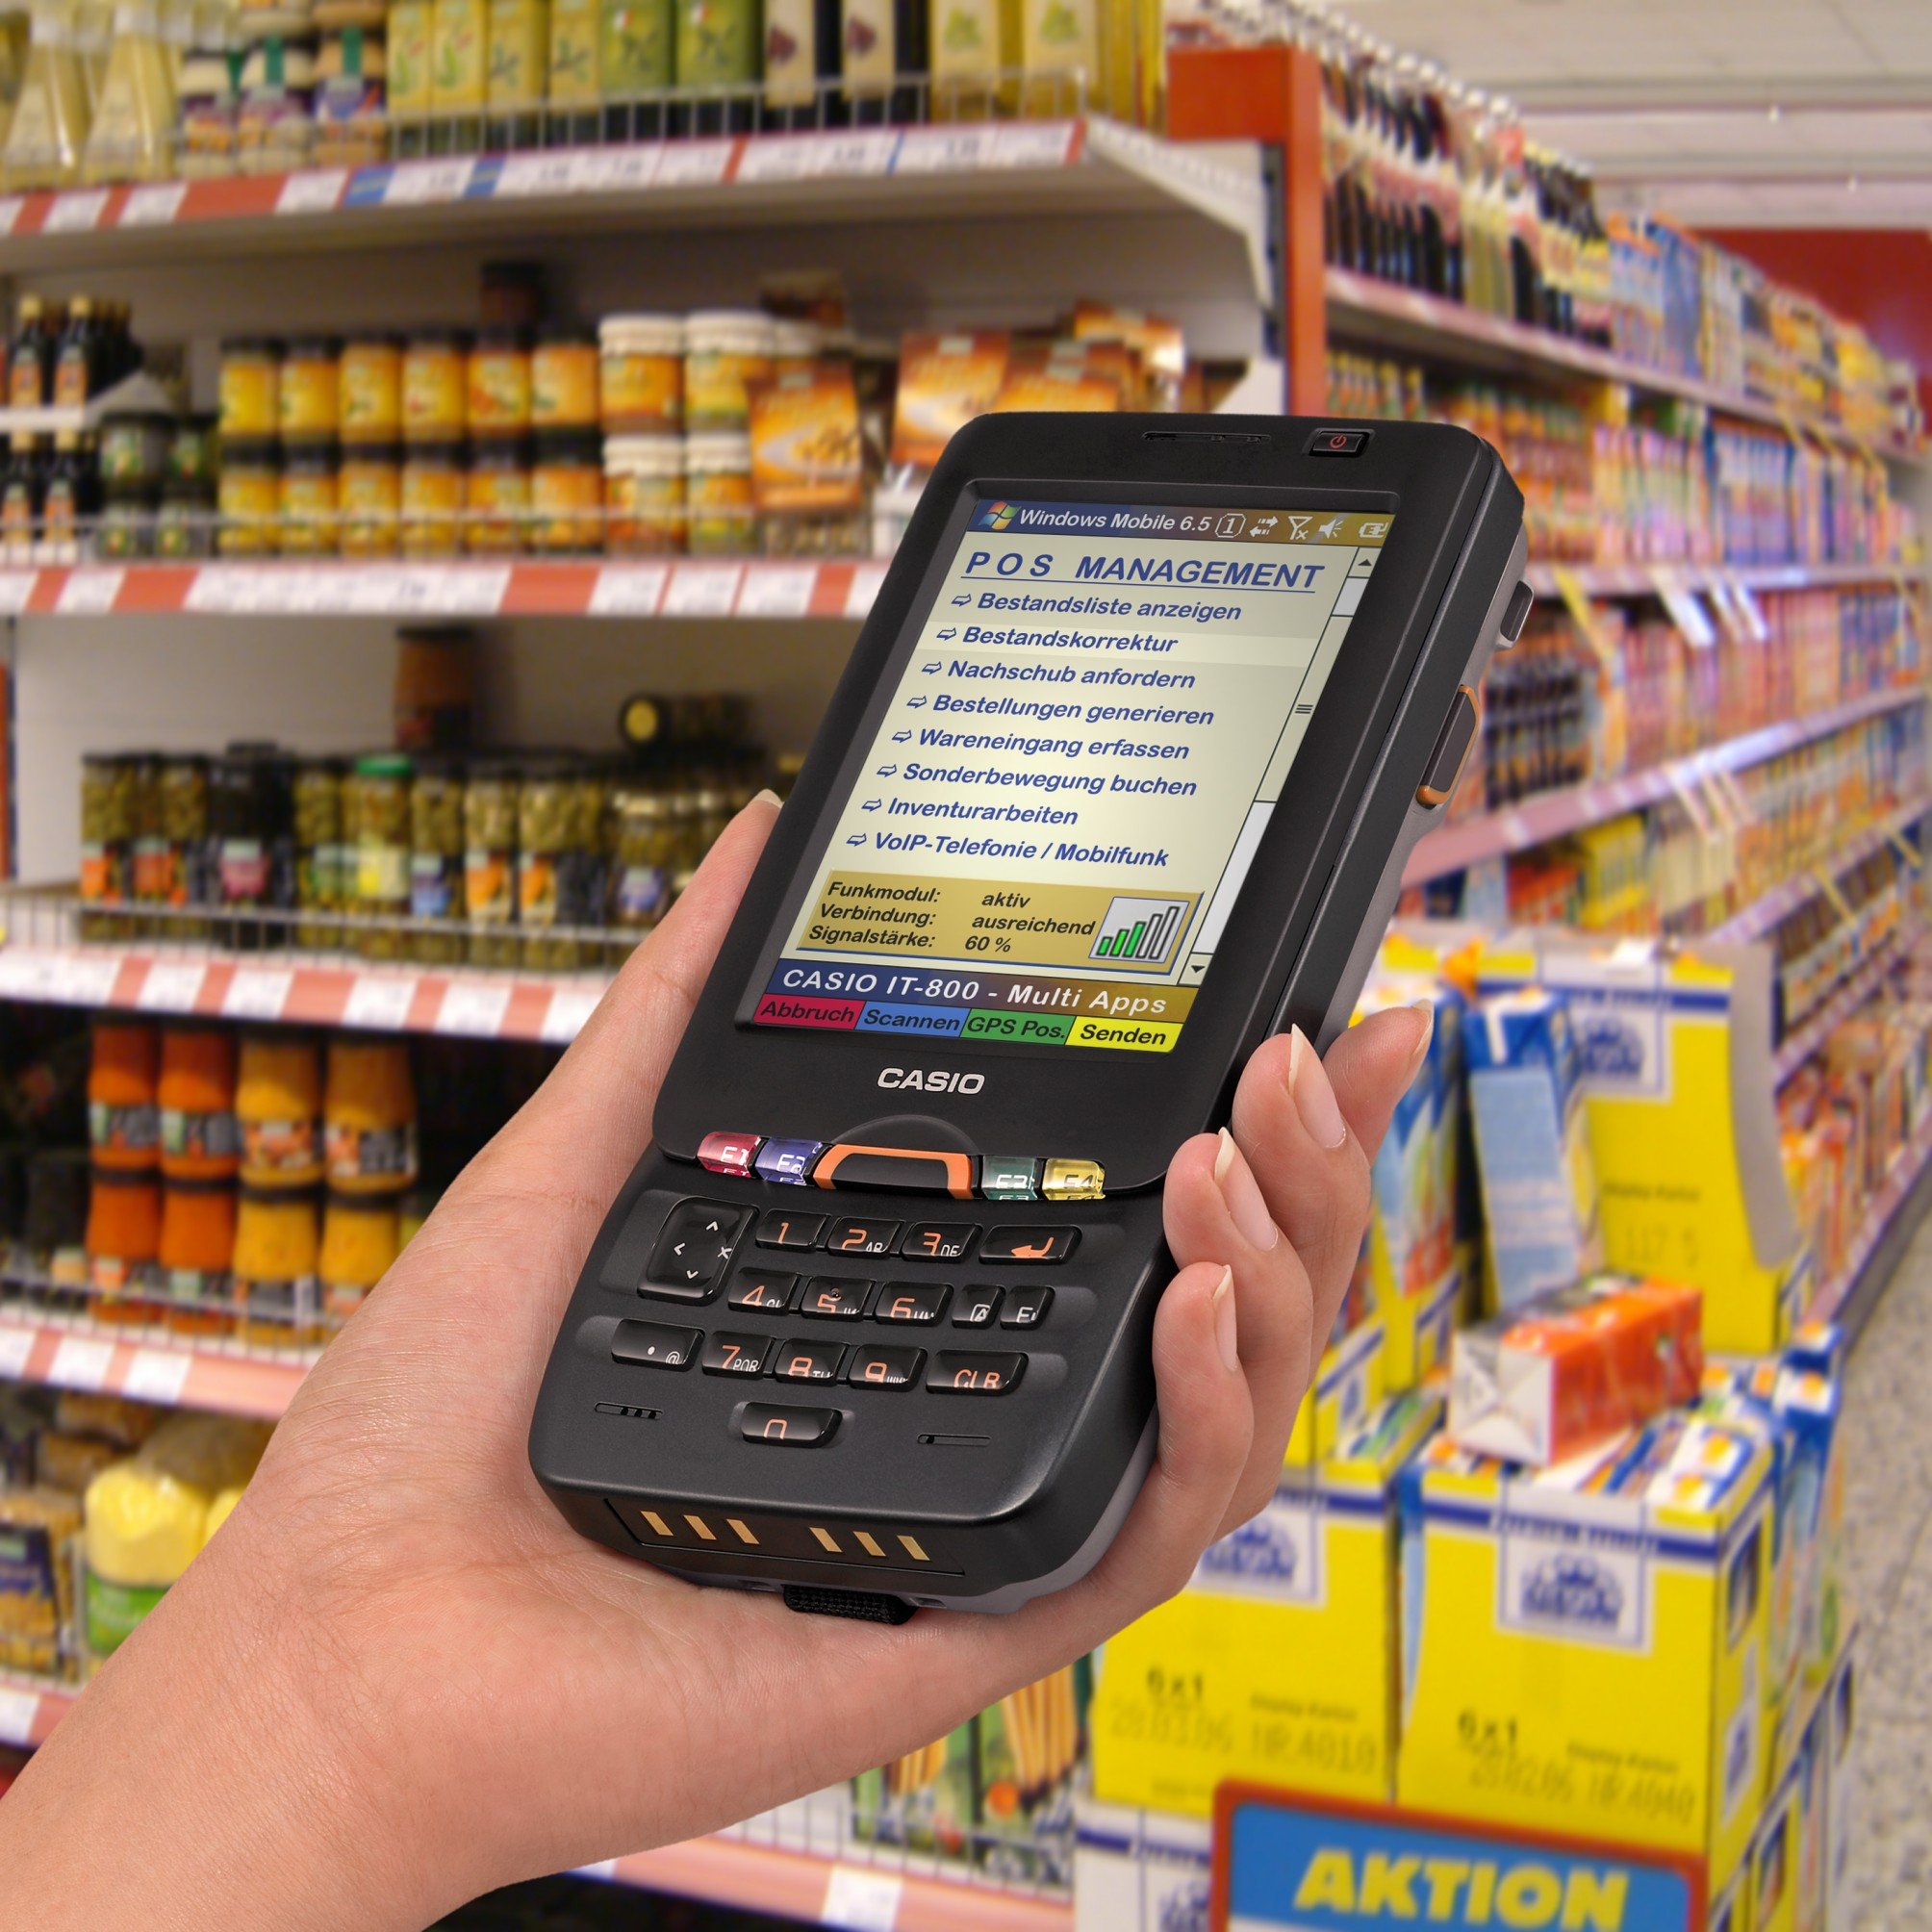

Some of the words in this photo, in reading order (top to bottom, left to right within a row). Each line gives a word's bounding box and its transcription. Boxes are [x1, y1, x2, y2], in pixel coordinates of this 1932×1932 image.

[1019, 508, 1106, 529] Windows
[1109, 511, 1175, 531] Mobile
[1180, 515, 1212, 532] 6.5
[1075, 556, 1325, 589] MANAGEMENT
[977, 593, 1132, 616] Bestandsliste
[1136, 601, 1242, 622] anzeigen
[962, 626, 1178, 652] Bestandskorrektur
[948, 660, 1076, 682] Nachschub
[1080, 667, 1196, 689] anfordern
[932, 695, 1081, 720] Bestellungen
[1085, 703, 1214, 724] generieren
[919, 728, 1082, 757] Wareneingang
[1088, 738, 1190, 759] erfassen
[902, 763, 1106, 794] Sonderbewegung
[1109, 774, 1198, 796] buchen
[887, 797, 1079, 825] Inventurarbeiten
[875, 832, 1036, 860] VoIP-Telefonie
[1054, 844, 1170, 867] Mobilfunk
[827, 882, 941, 902] Funkmodul:
[981, 892, 1030, 908] aktiv
[820, 903, 936, 927] Verbindung:
[971, 913, 1096, 936] ausreichend
[808, 926, 935, 950] Signalstärke:
[964, 935, 989, 952] 60
[782, 969, 877, 994] CASIO
[886, 976, 979, 1001] IT-800
[1007, 984, 1080, 1008] Multi
[1089, 991, 1166, 1017] Apps
[760, 1000, 855, 1026] Abbruch
[864, 1009, 960, 1032] Scannen
[967, 1016, 1015, 1036] GPS
[1020, 1019, 1066, 1040] Pos.
[1080, 1024, 1166, 1047] Senden
[877, 1068, 985, 1095] CASIO
[778, 1222, 790, 1244] 1
[841, 1228, 867, 1250] 2
[742, 1285, 765, 1306] 4
[722, 1345, 740, 1369] 7
[1293, 1847, 1630, 1932] AKTION
